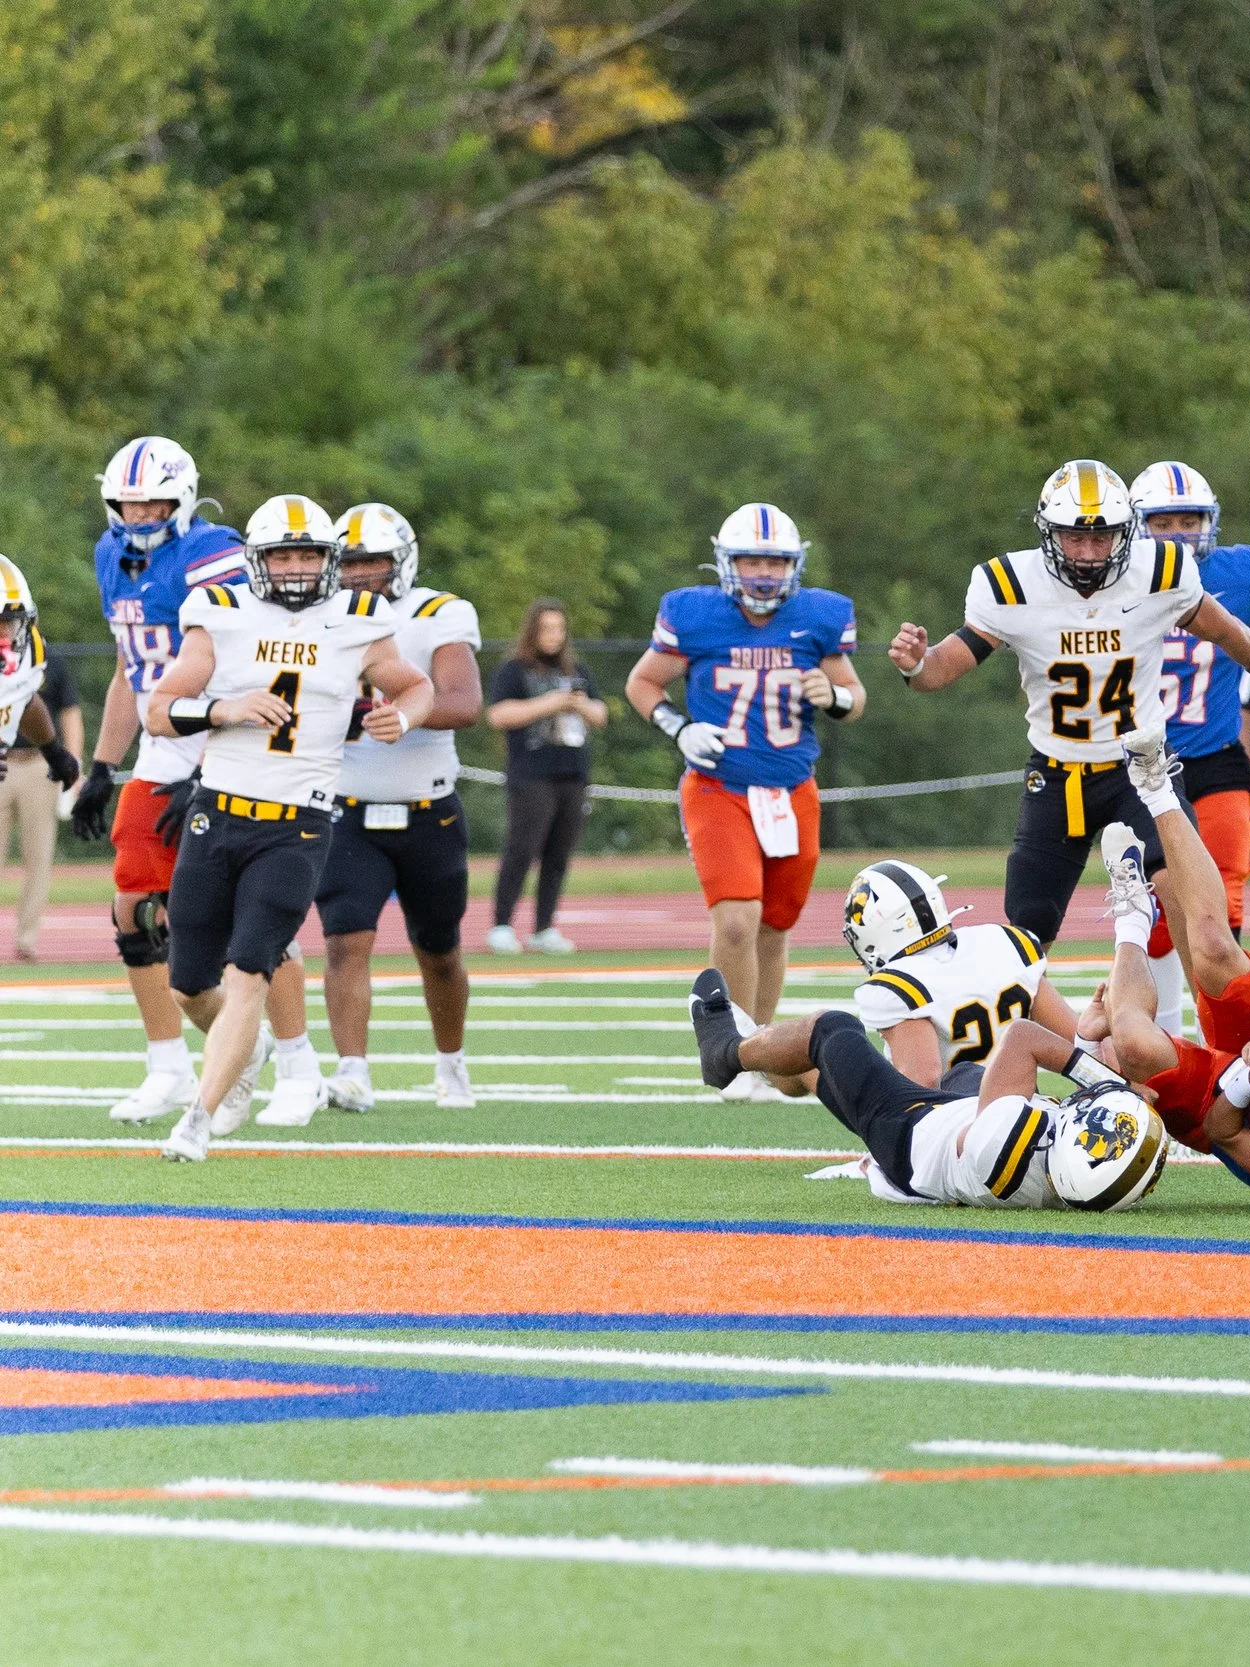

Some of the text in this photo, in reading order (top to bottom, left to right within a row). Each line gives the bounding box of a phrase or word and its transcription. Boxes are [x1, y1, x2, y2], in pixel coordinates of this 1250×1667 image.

[255, 639, 318, 666] NEERS
[730, 647, 794, 669] BRUINS
[1060, 629, 1121, 655] NEERS
[1160, 640, 1214, 724] 51
[266, 670, 301, 754] 4
[714, 665, 803, 748] 70
[1047, 656, 1138, 743] 24
